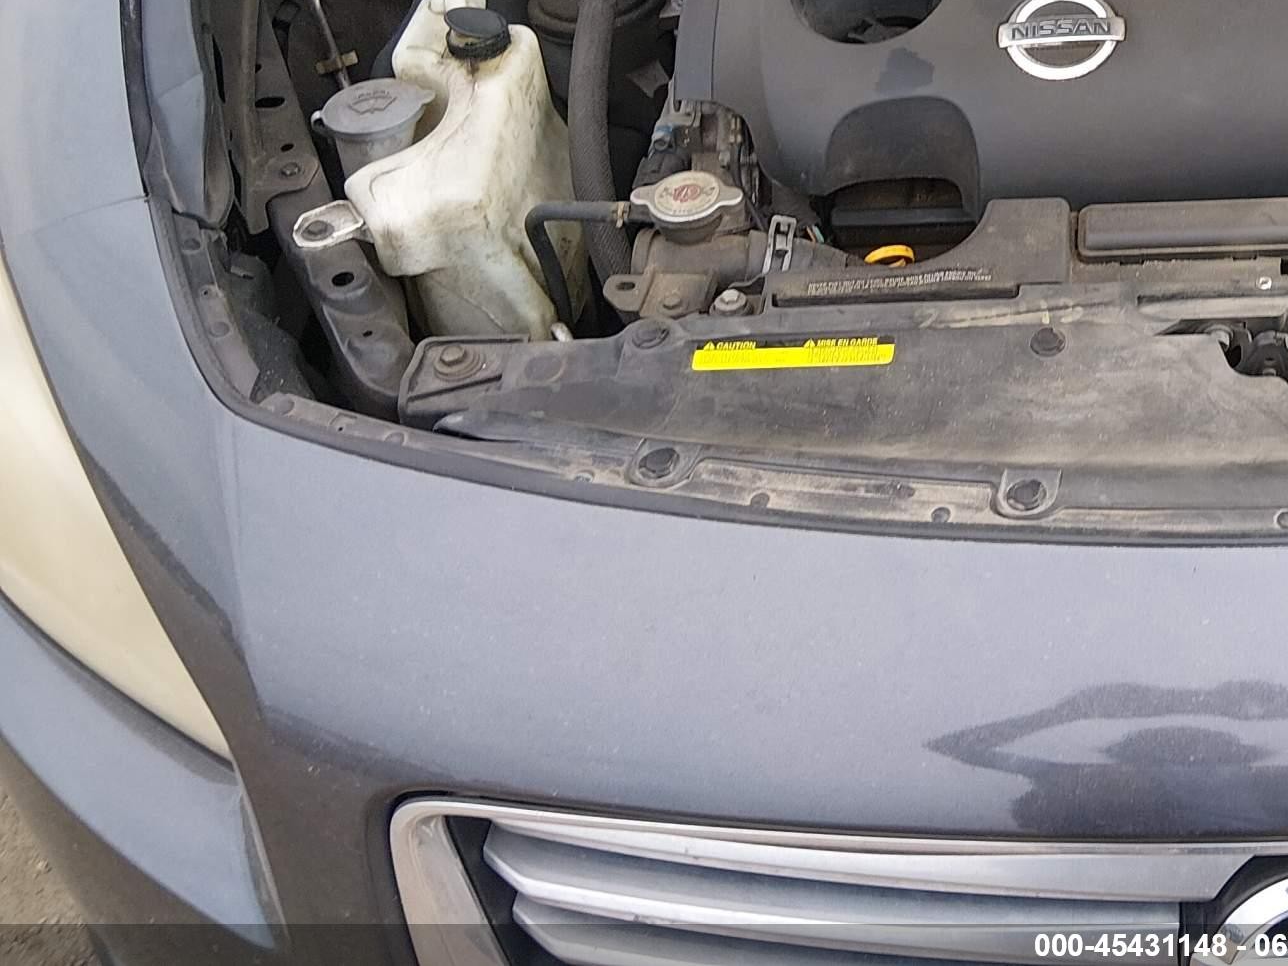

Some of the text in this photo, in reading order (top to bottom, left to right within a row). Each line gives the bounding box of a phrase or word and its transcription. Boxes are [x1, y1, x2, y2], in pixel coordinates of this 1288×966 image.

[1011, 17, 1111, 41] NISSAN
[716, 340, 757, 351] CAUTION
[816, 337, 879, 347] MISE EN GARDE
